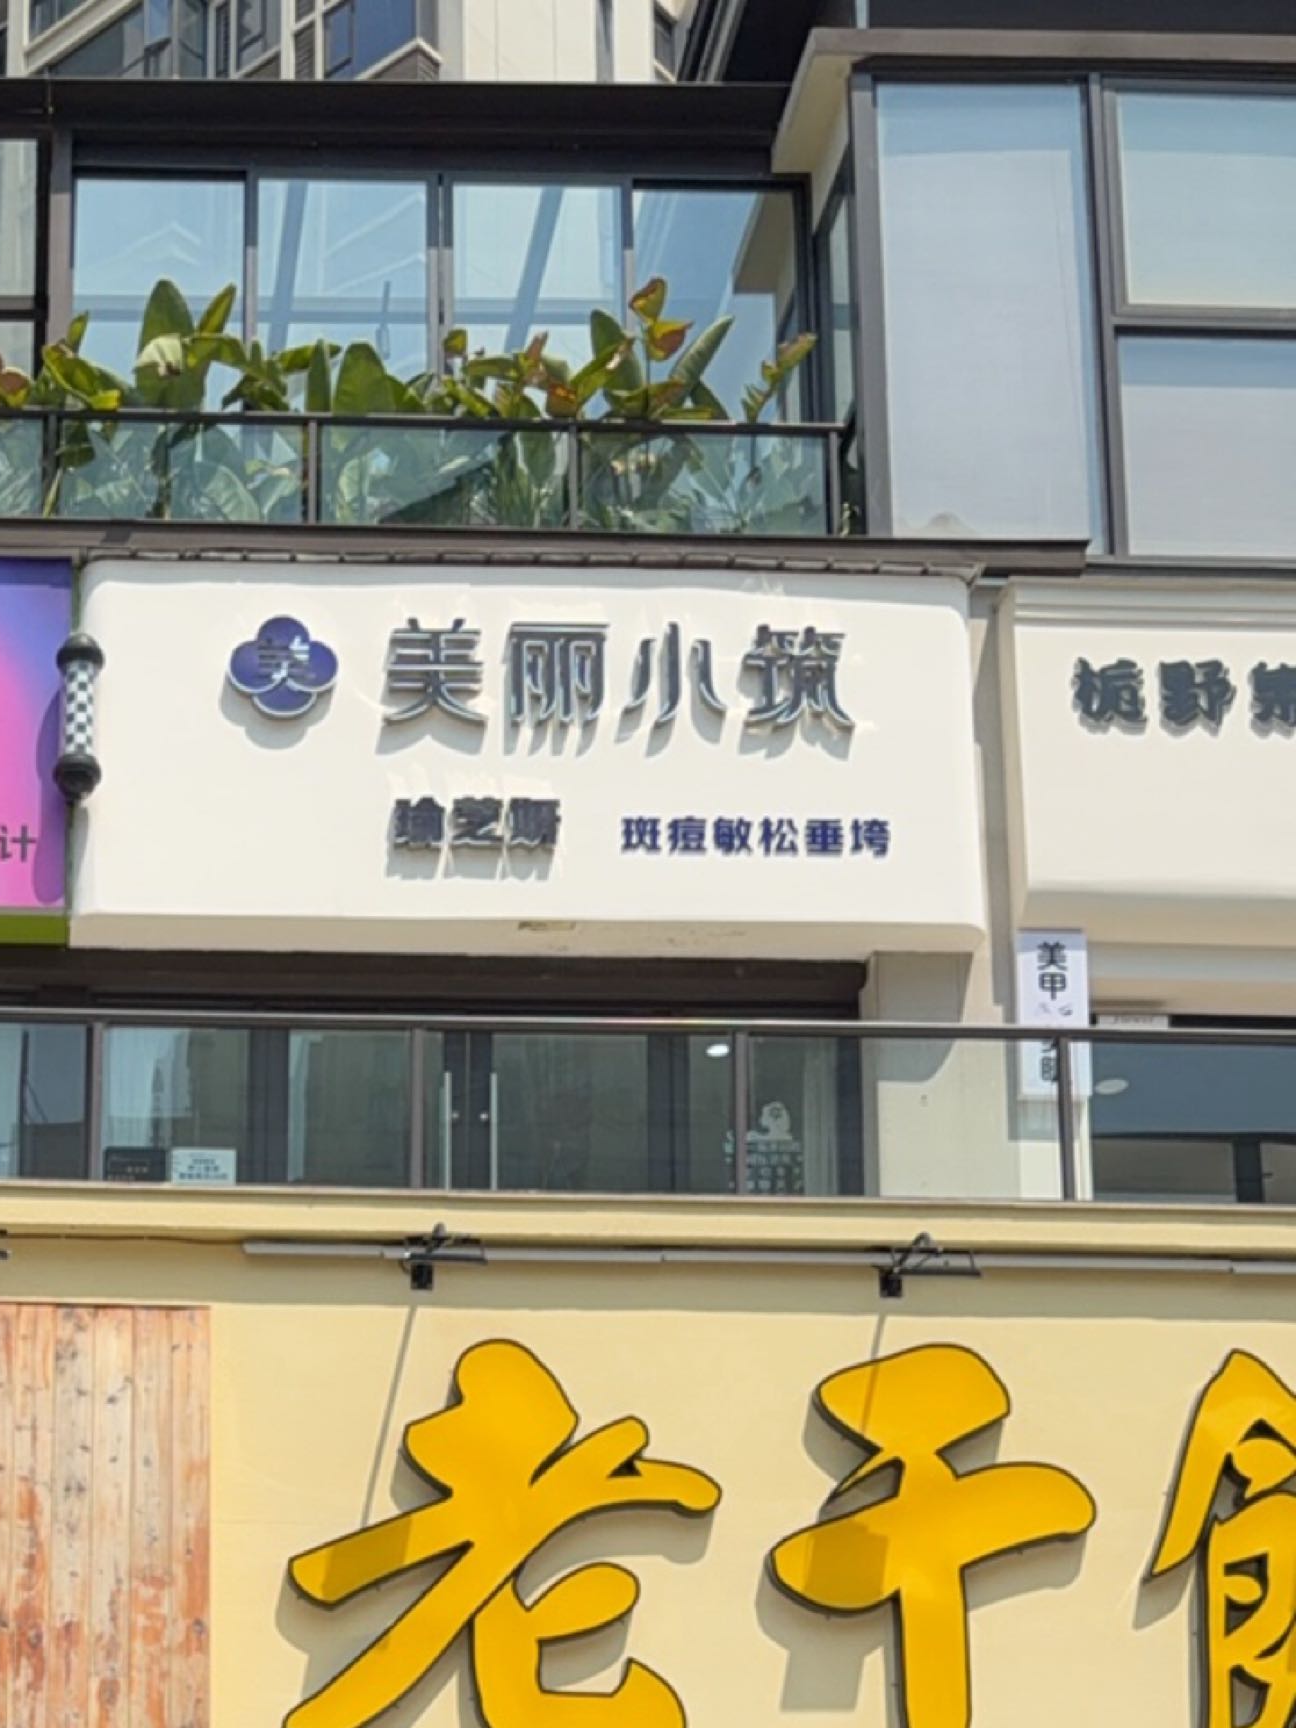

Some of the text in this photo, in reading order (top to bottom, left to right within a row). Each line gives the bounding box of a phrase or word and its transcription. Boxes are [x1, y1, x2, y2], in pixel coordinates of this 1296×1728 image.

[383, 616, 854, 729] 美丽小筑
[619, 815, 892, 859] 斑痘敏松垂垮
